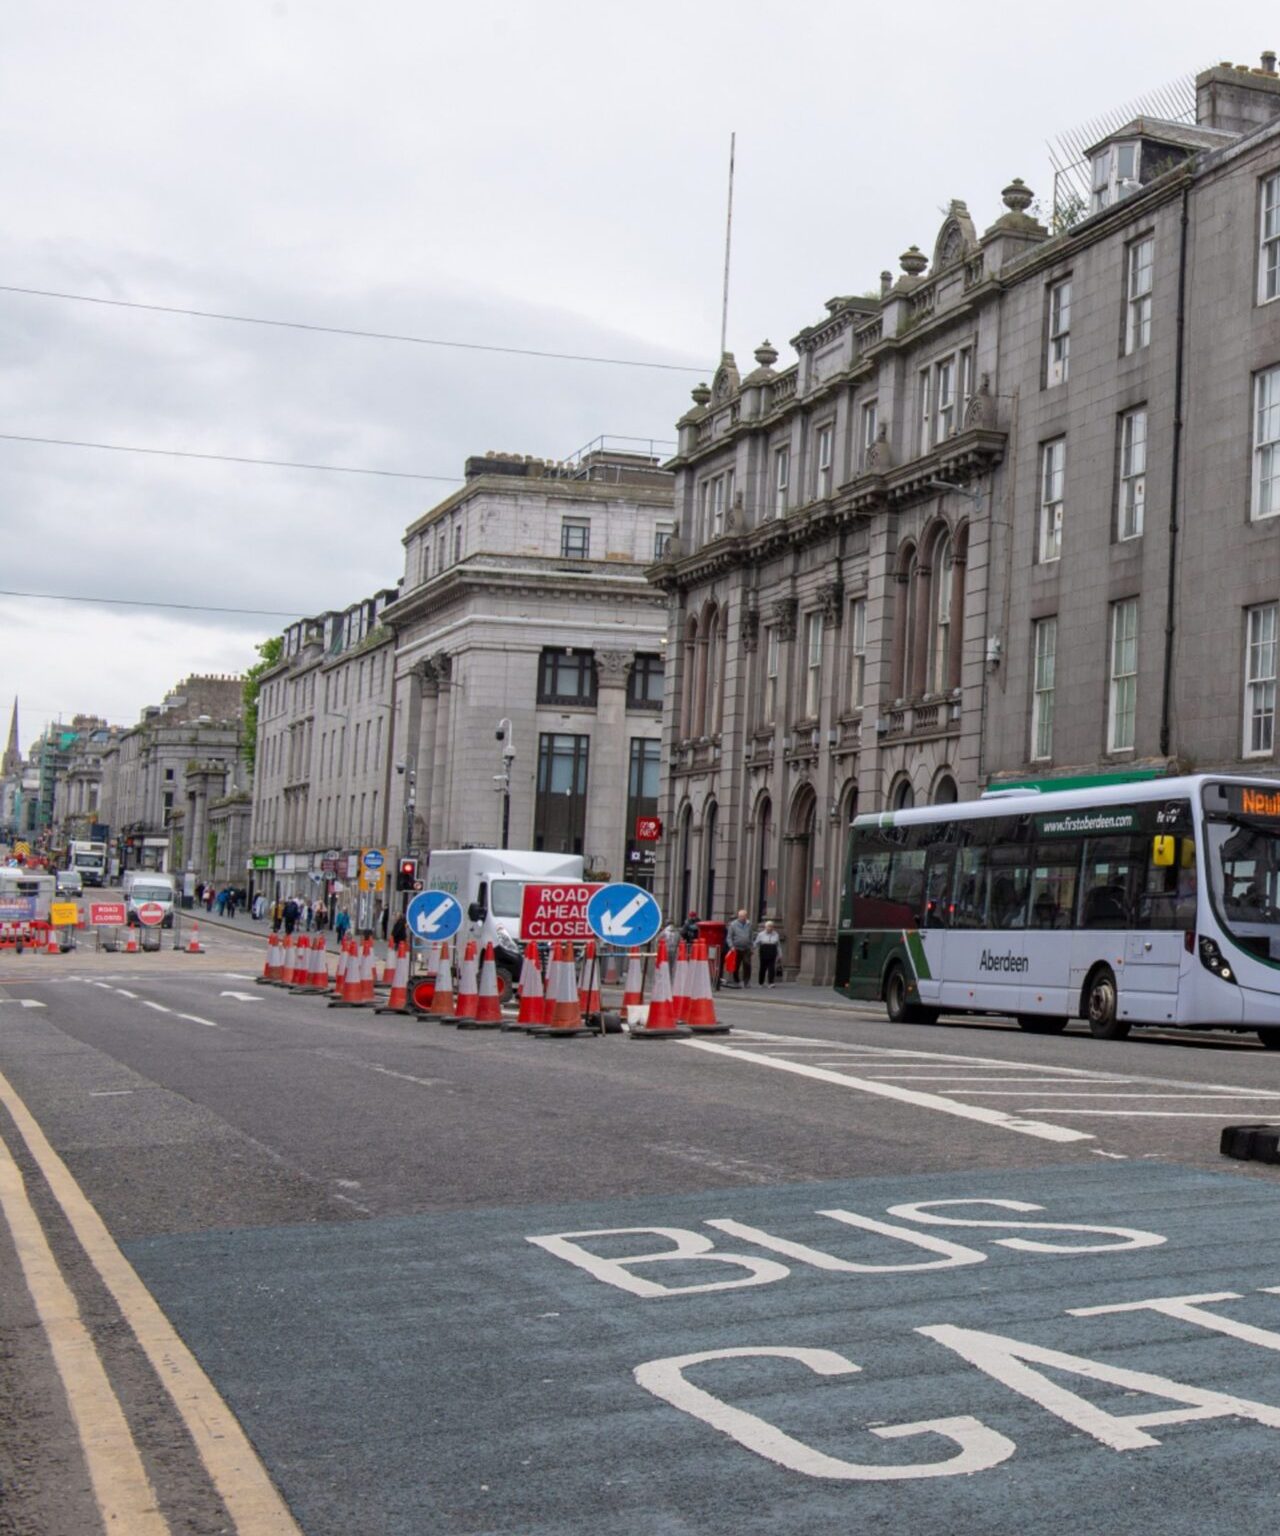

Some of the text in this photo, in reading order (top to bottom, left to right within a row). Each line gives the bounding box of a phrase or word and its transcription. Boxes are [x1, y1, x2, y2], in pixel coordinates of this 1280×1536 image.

[1043, 813, 1133, 832] www.firstaberdeen.com
[541, 888, 589, 902] ROAD
[534, 903, 588, 919] AHEAD
[528, 920, 593, 937] CLOSED
[979, 949, 1029, 973] Aberdeen
[525, 1197, 1168, 1298] BUS
